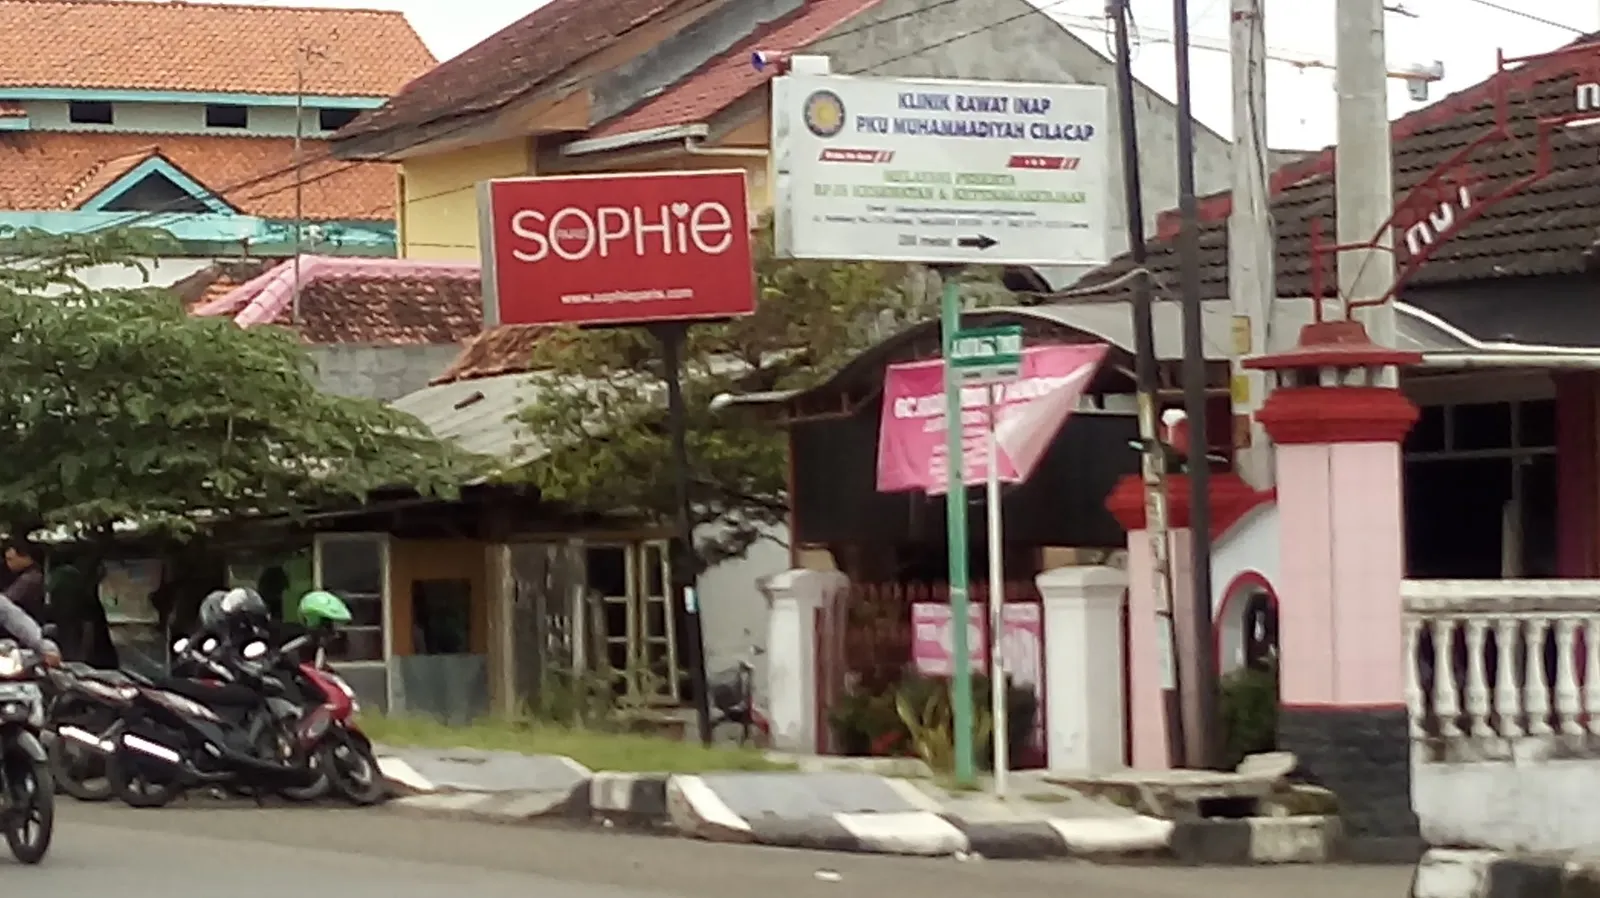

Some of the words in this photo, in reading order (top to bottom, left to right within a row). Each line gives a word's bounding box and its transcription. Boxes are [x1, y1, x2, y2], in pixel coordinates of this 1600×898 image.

[898, 92, 951, 111] KLINIK
[955, 94, 1009, 114] RAWAT
[1013, 97, 1051, 115] INAP
[856, 115, 889, 134] PKU
[893, 117, 1026, 139] MUHAMMADIYAH
[1029, 122, 1095, 141] CILACAP
